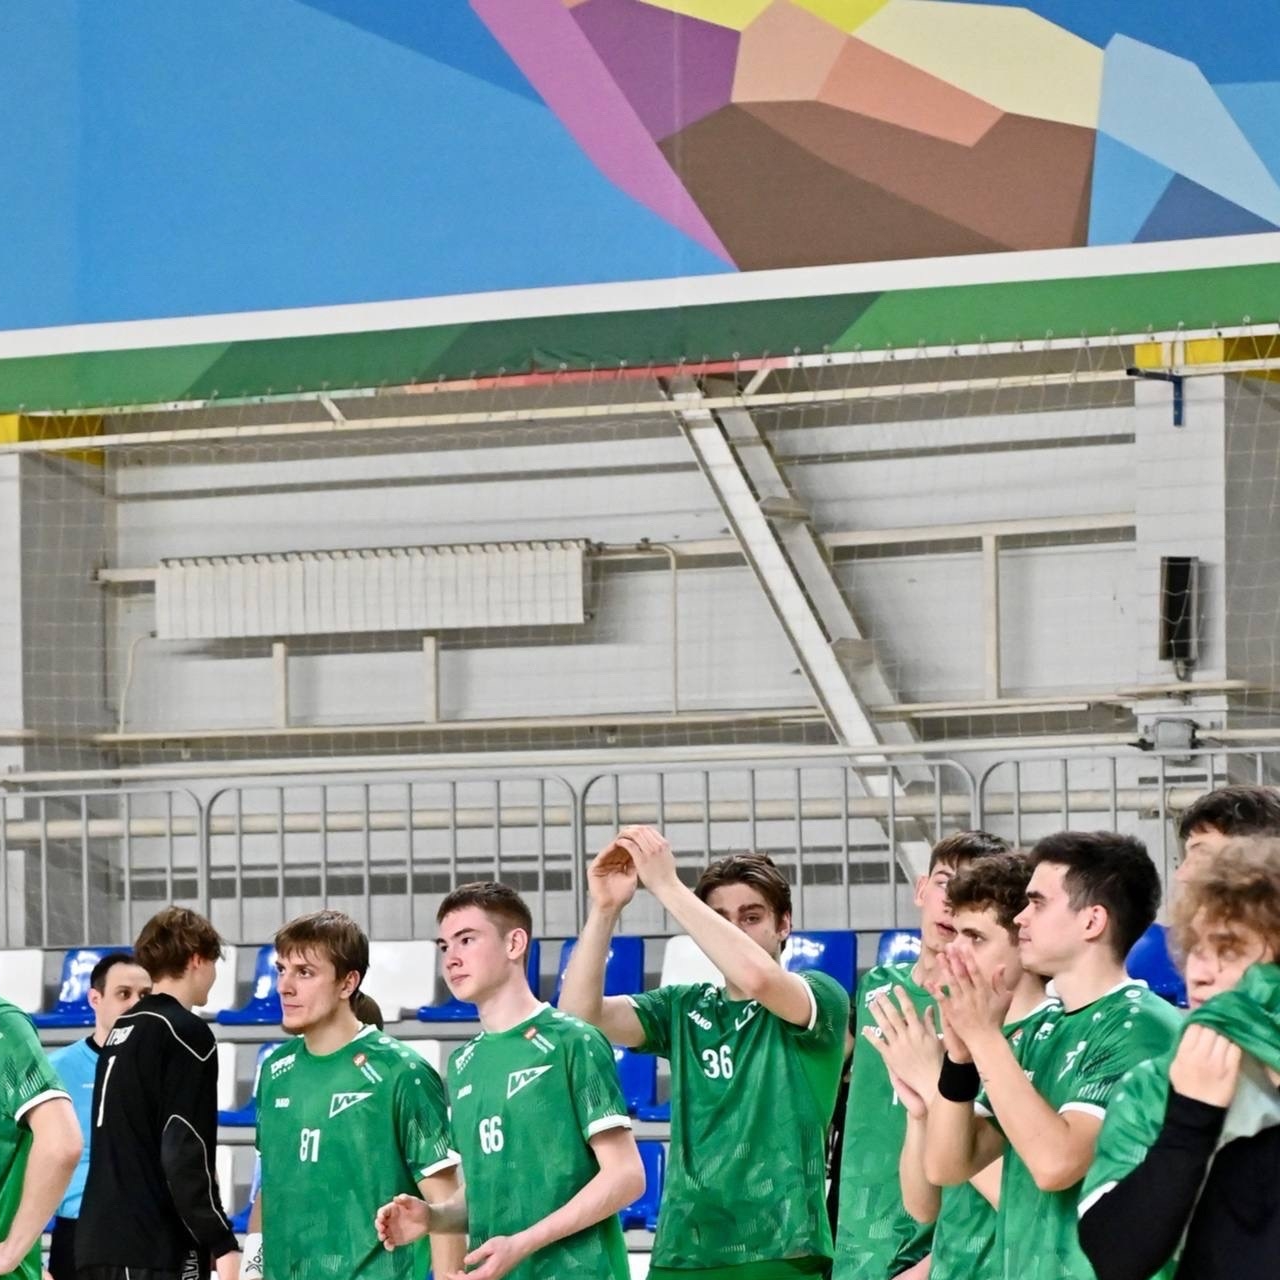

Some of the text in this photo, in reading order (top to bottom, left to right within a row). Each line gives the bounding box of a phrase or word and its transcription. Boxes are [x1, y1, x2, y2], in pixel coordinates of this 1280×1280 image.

[702, 1045, 733, 1079] 36
[300, 1128, 320, 1162] 81
[479, 1115, 504, 1154] 66
